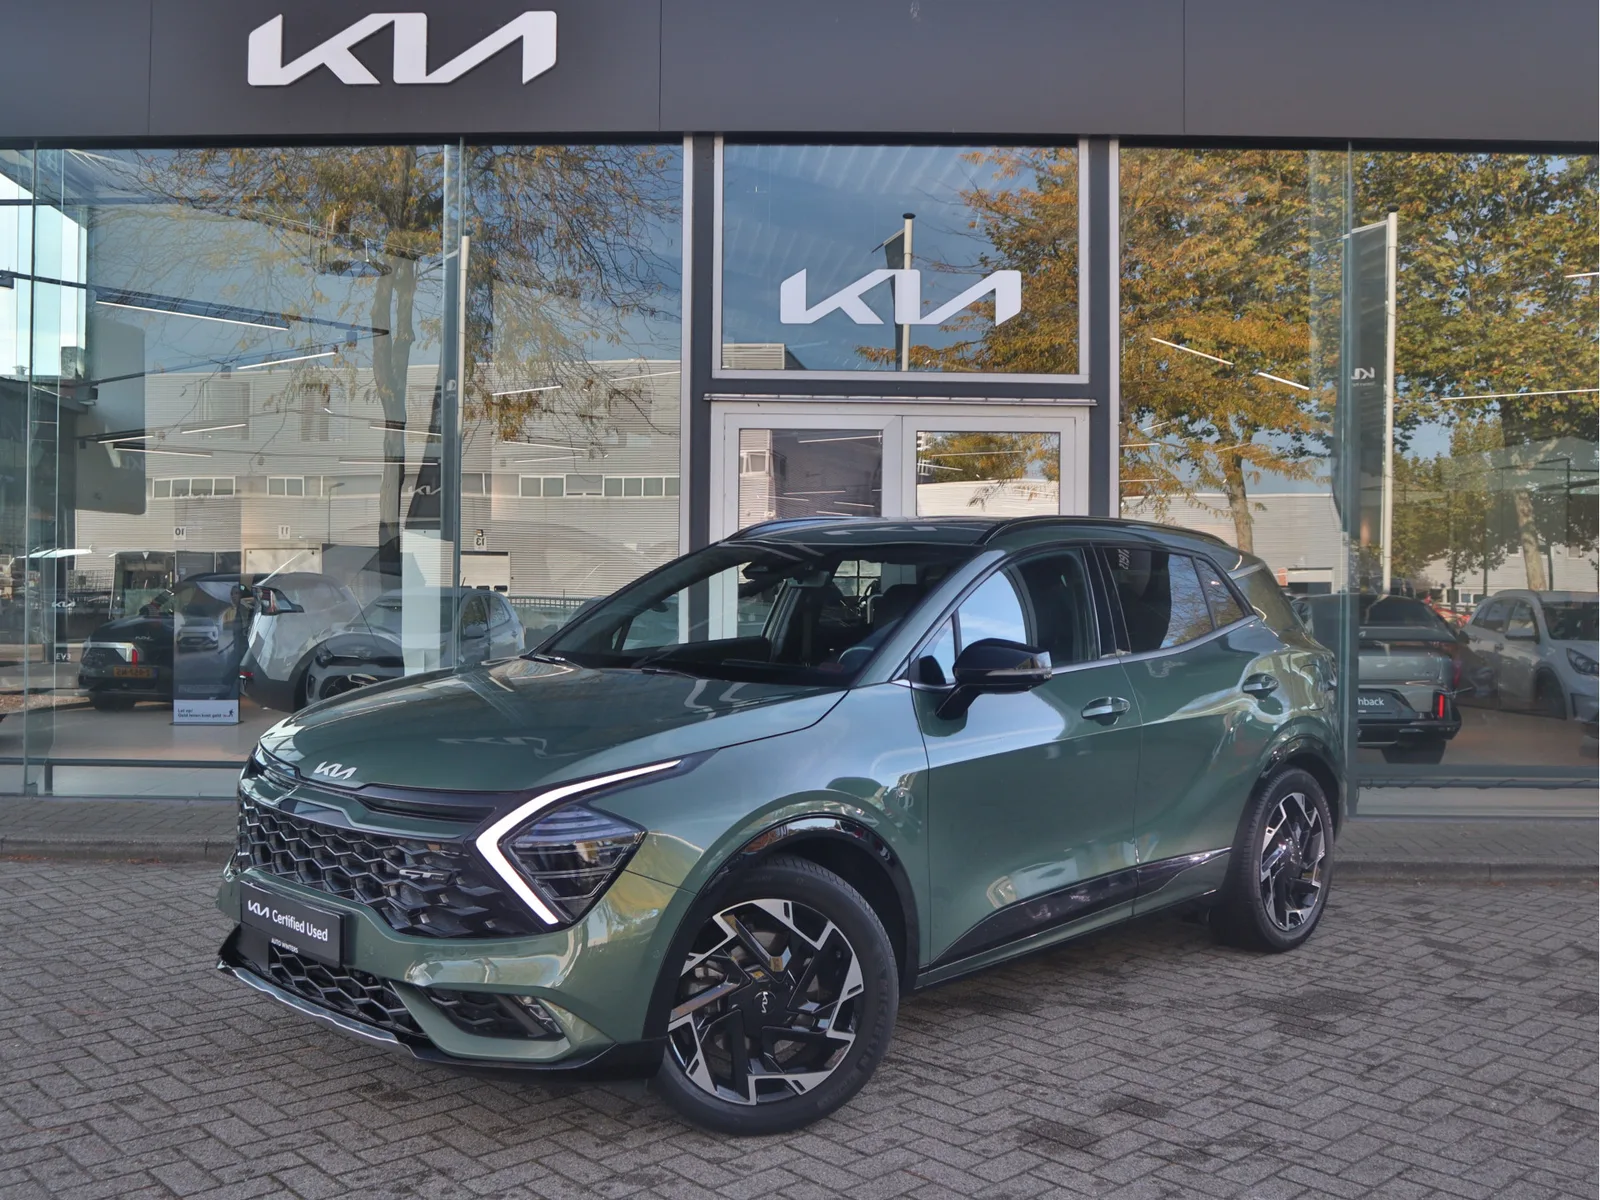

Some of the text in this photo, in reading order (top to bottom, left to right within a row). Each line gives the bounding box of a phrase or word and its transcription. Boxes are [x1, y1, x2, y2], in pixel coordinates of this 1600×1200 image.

[247, 10, 557, 86] KIA
[780, 268, 1021, 326] KIA
[313, 760, 358, 780] KIA
[247, 899, 329, 942] KIA Certified Used
[270, 937, 282, 947] AUTO
